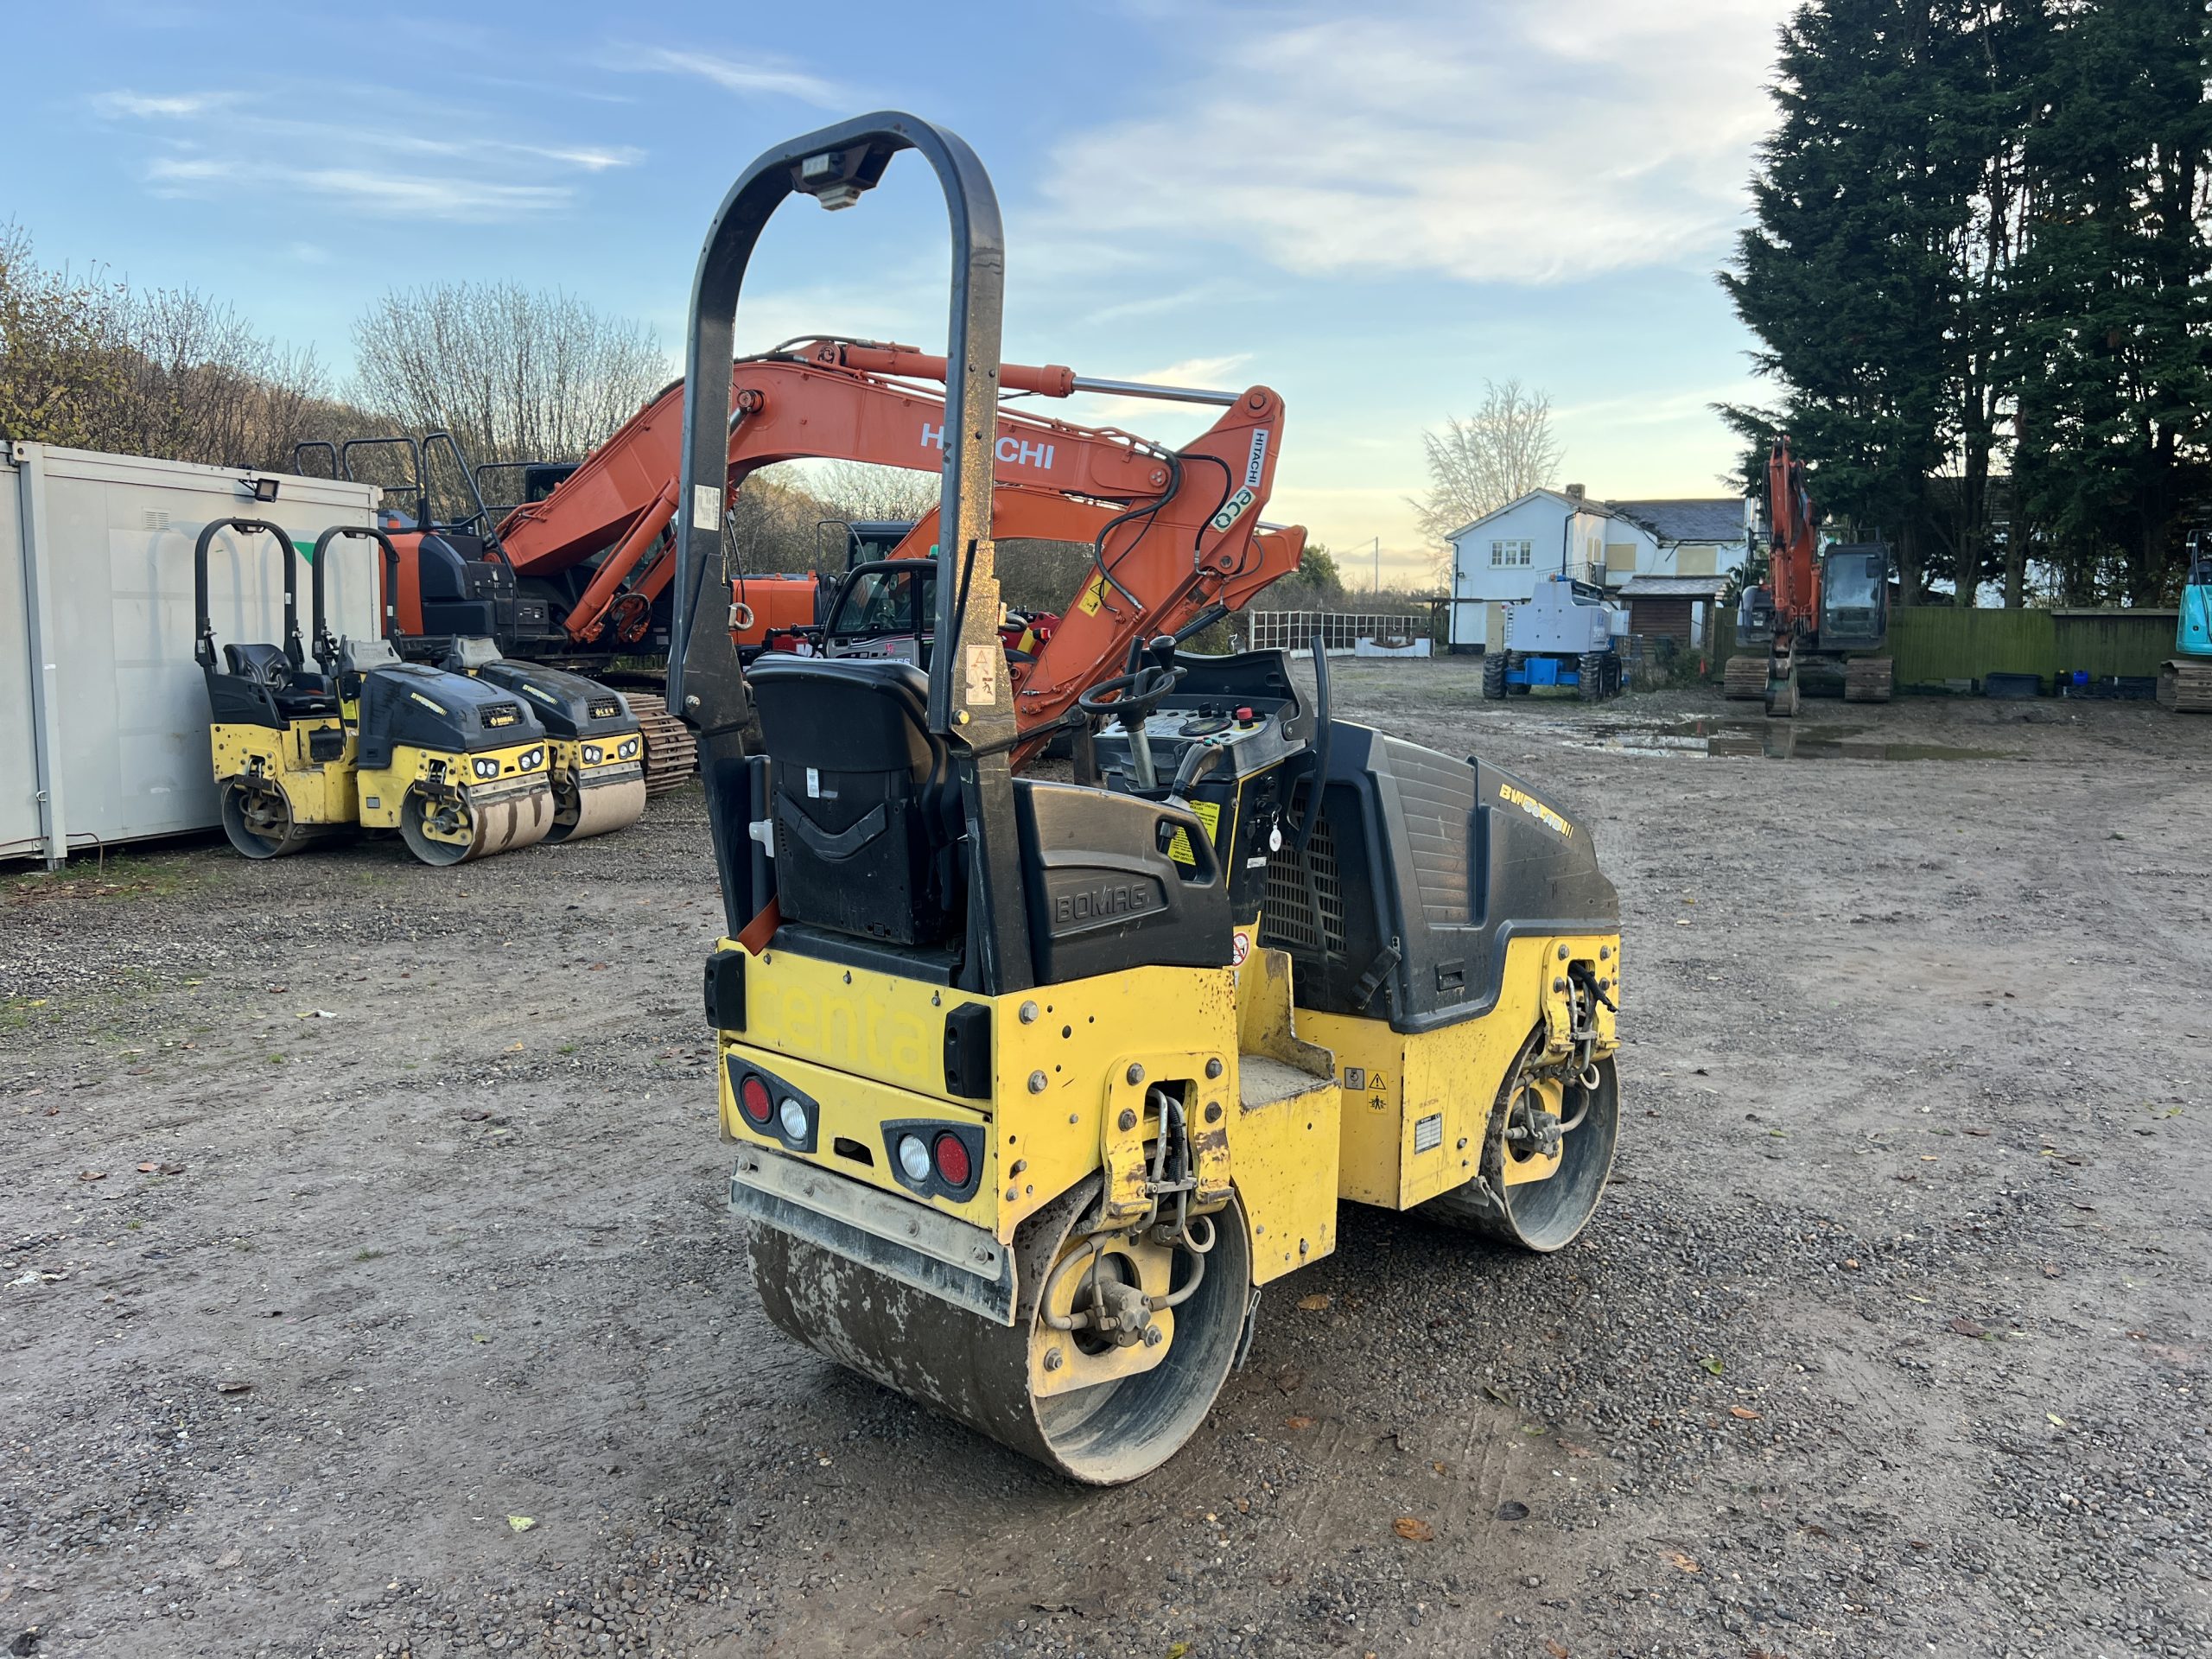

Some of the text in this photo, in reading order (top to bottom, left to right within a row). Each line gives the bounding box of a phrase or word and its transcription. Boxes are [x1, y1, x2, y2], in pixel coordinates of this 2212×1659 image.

[920, 423, 1054, 469] HCHI
[1248, 433, 1264, 483] HITACHI
[1214, 489, 1252, 529] eco
[1055, 883, 1150, 924] BOMAG
[749, 980, 945, 1080] centa
